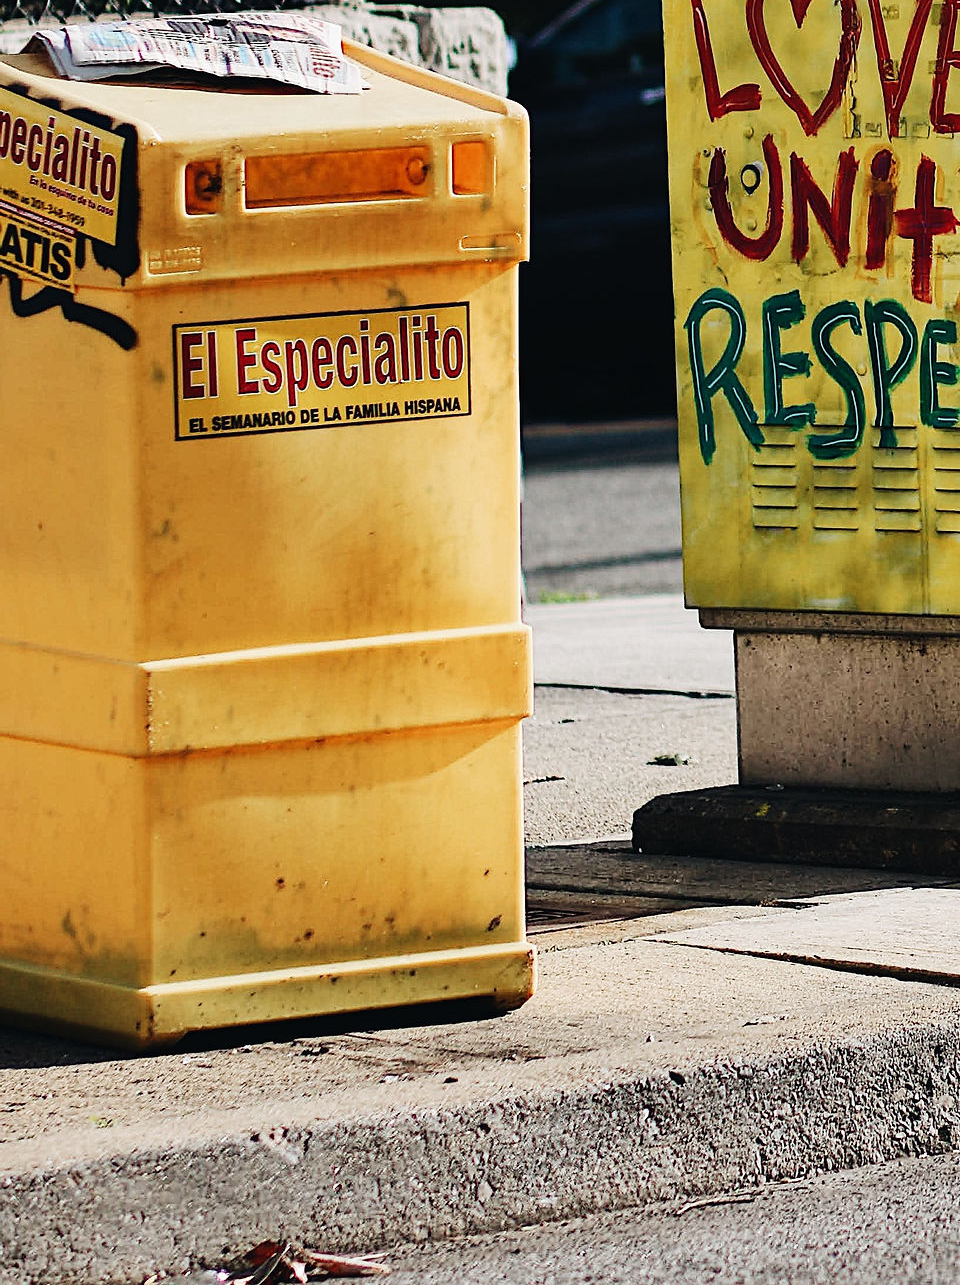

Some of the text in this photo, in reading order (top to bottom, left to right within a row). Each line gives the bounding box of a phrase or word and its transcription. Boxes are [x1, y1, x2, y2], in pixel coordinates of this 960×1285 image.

[181, 315, 465, 408] El Especialito
[189, 397, 462, 434] EL SEMANARIO DE LA FAMILIA HISPANA
